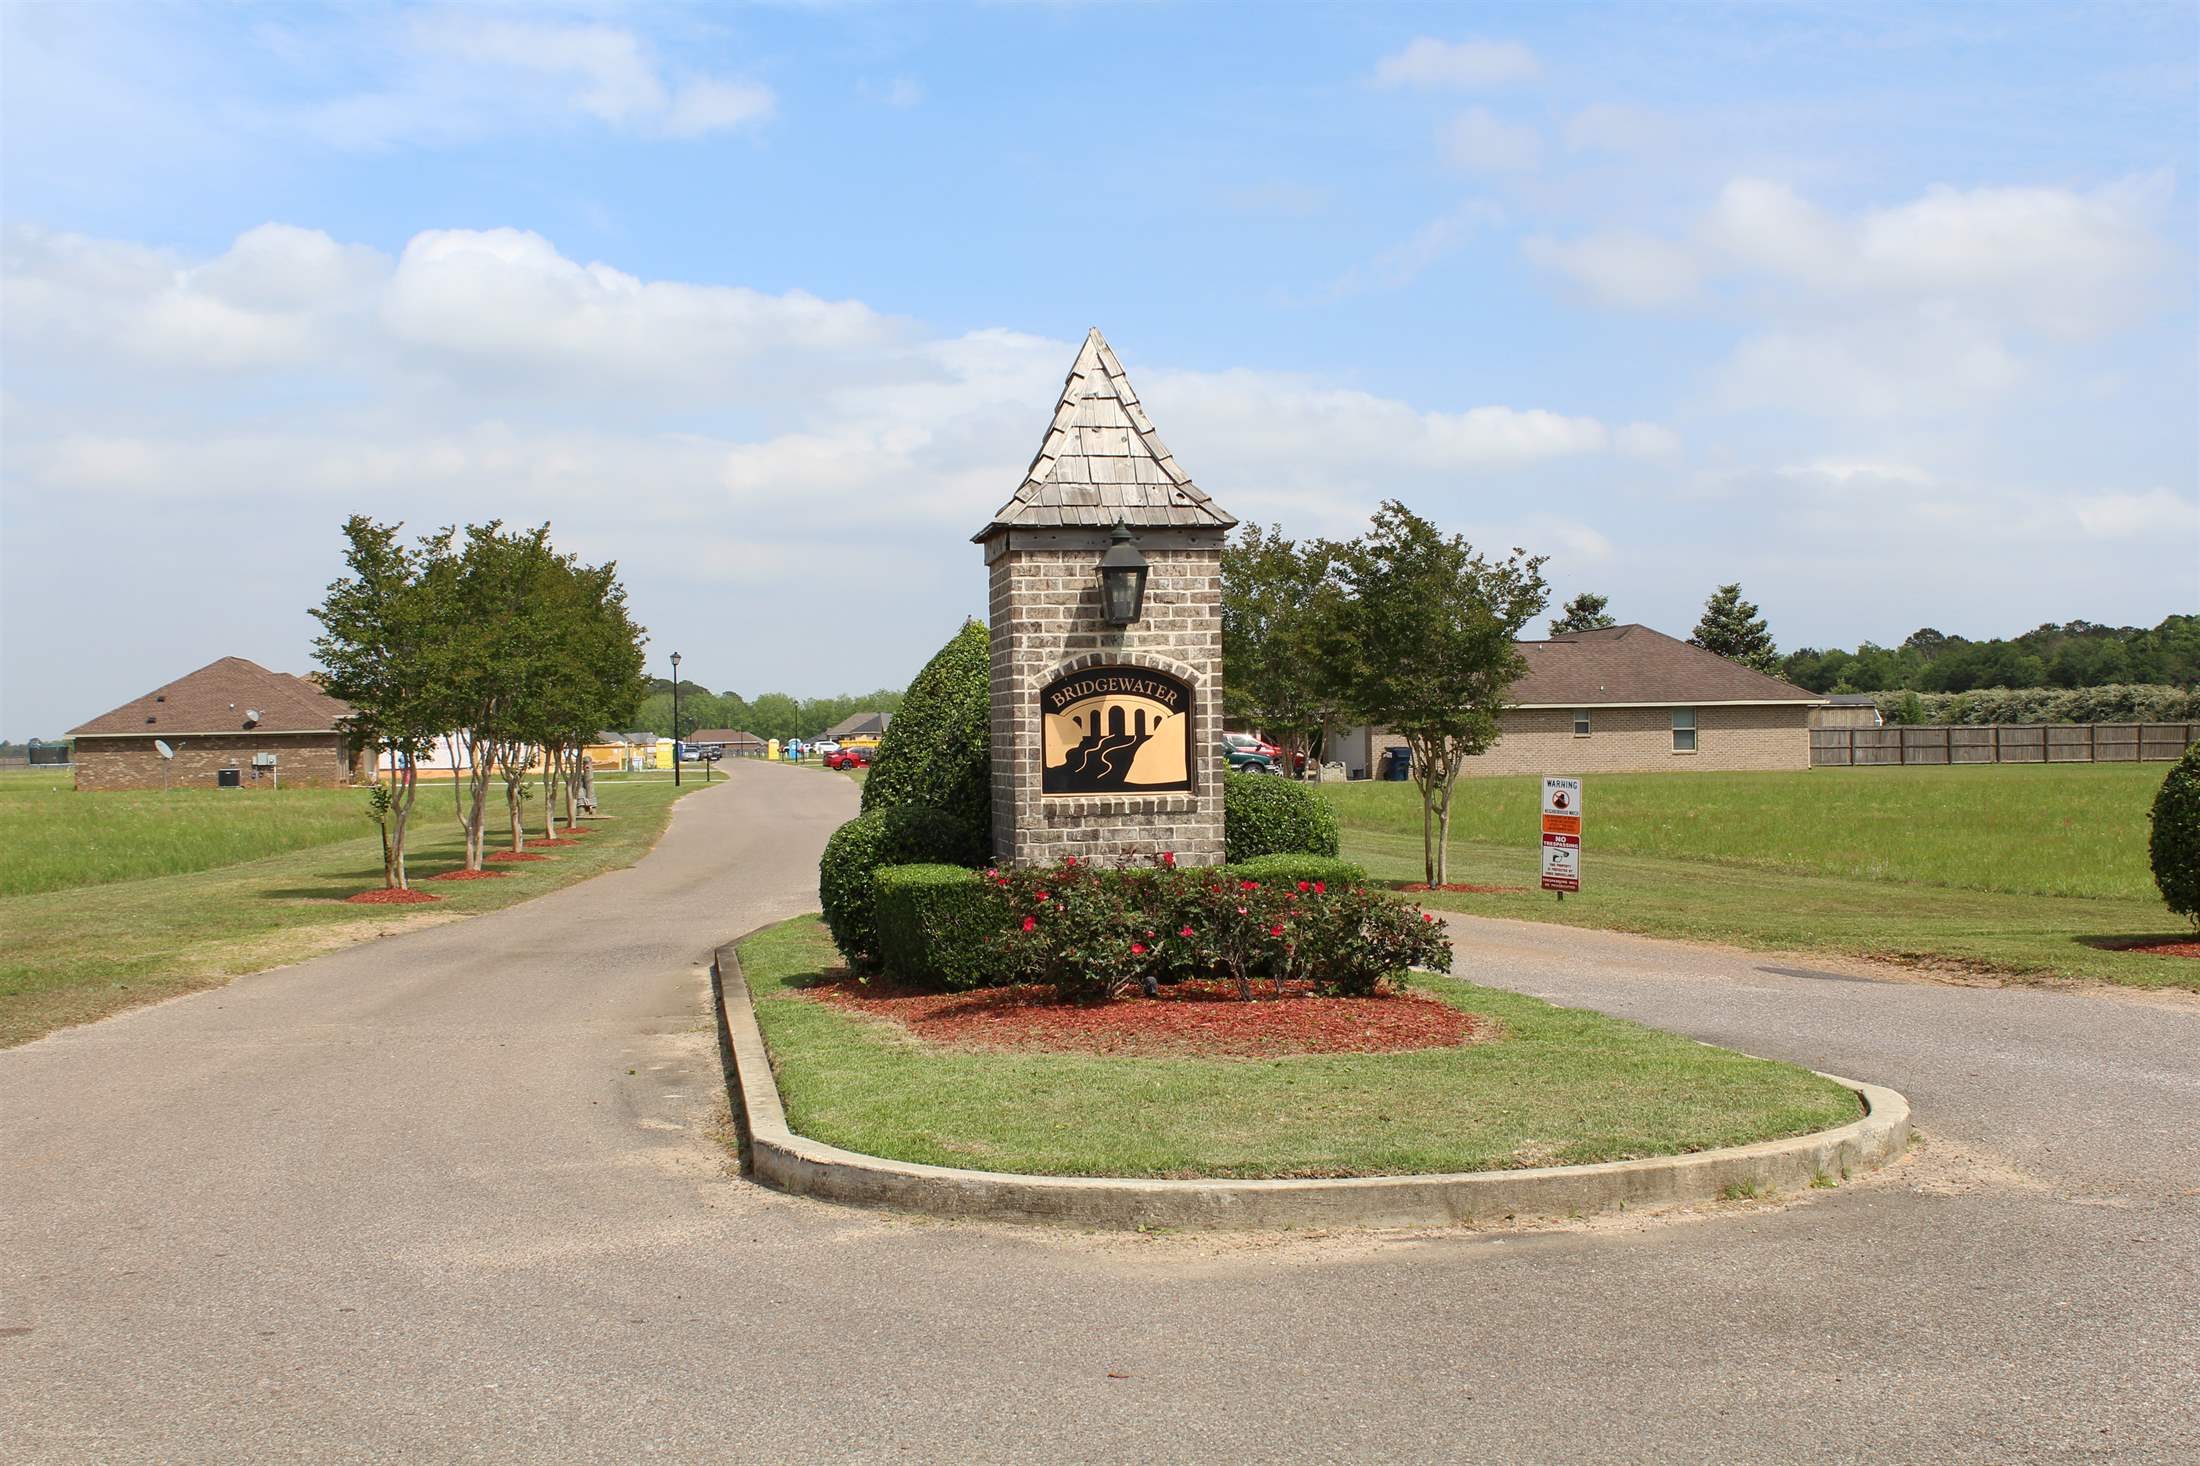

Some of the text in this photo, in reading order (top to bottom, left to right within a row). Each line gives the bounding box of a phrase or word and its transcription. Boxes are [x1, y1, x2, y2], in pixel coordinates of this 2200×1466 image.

[1051, 678, 1178, 707] BRIDGEWATER
[1547, 780, 1577, 789] WARNING
[1543, 841, 1579, 849] TRESPASSING
